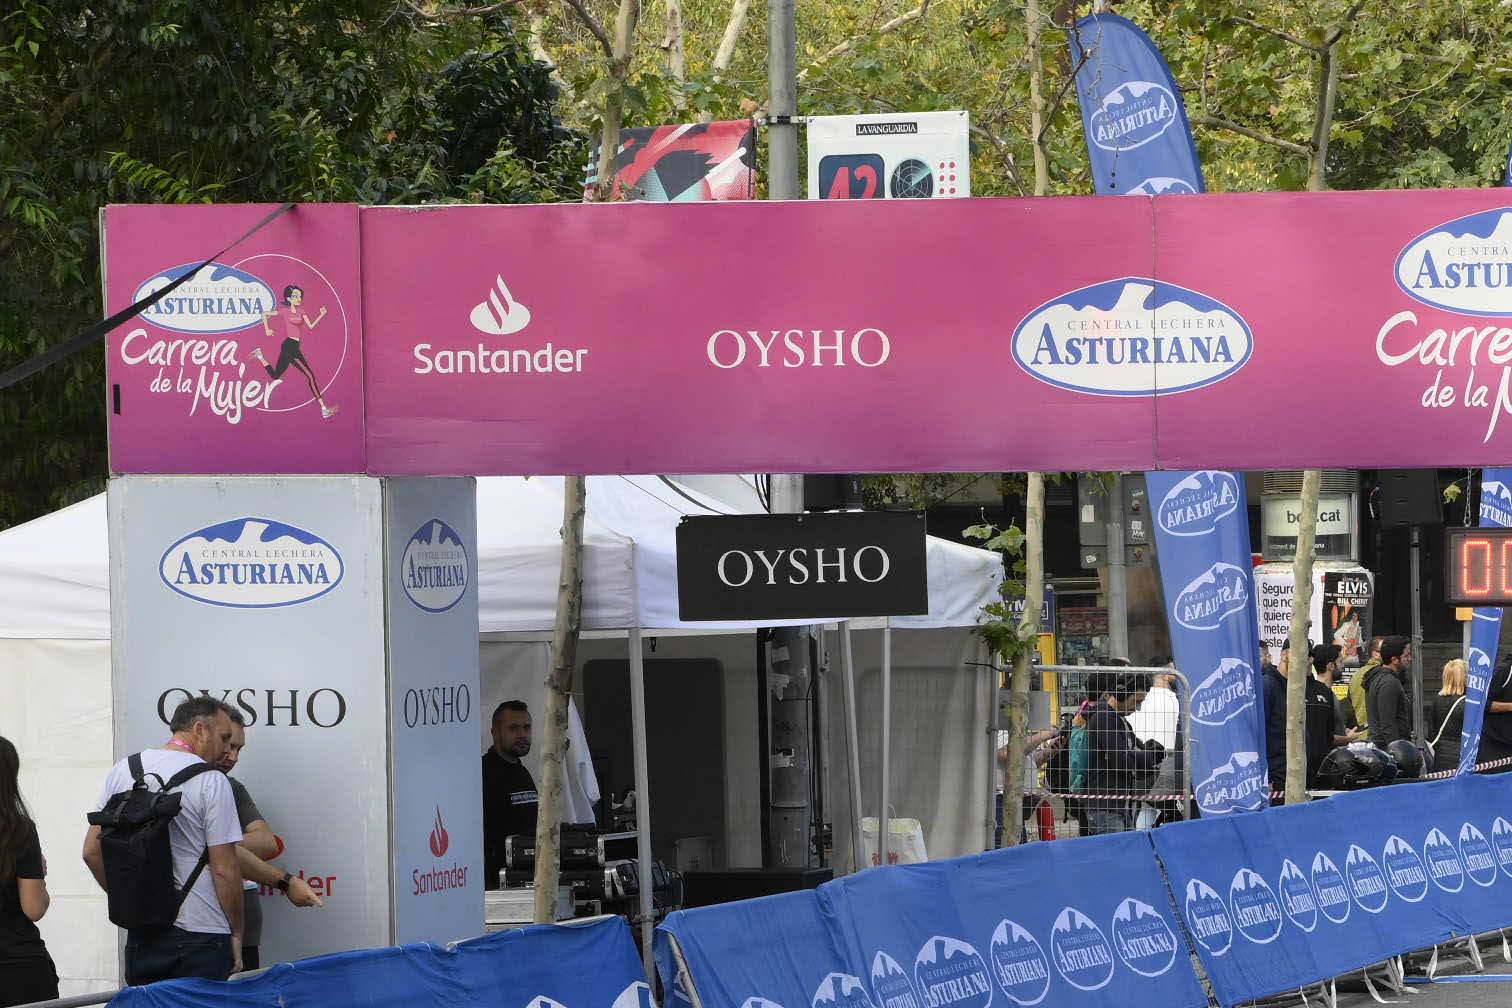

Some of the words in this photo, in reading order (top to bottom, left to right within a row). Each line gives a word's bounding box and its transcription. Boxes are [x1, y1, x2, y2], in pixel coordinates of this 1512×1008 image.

[144, 288, 264, 315] ASTURIANA
[172, 286, 211, 294] ENTRAL
[1067, 319, 1142, 331] CENTRAL
[1150, 318, 1226, 330] LECHERA
[120, 328, 240, 367] Carrera
[413, 342, 589, 375] Santander
[706, 327, 892, 369] OYSHO
[1030, 322, 1235, 366] ASTURIANA
[150, 367, 173, 394] de
[177, 365, 193, 394] la
[190, 361, 283, 425] Mujer
[1421, 369, 1456, 409] de
[1464, 367, 1489, 408] la
[174, 551, 331, 585] ASTURIANA
[202, 549, 259, 559] CENTRAL
[265, 549, 324, 558] LECHERA
[406, 552, 466, 590] ASTURIANA
[717, 544, 891, 588] OYSHO
[1262, 599, 1280, 610] que
[1337, 581, 1368, 594] ELVIS
[404, 683, 471, 729] OYSHO
[412, 862, 469, 897] Santander
